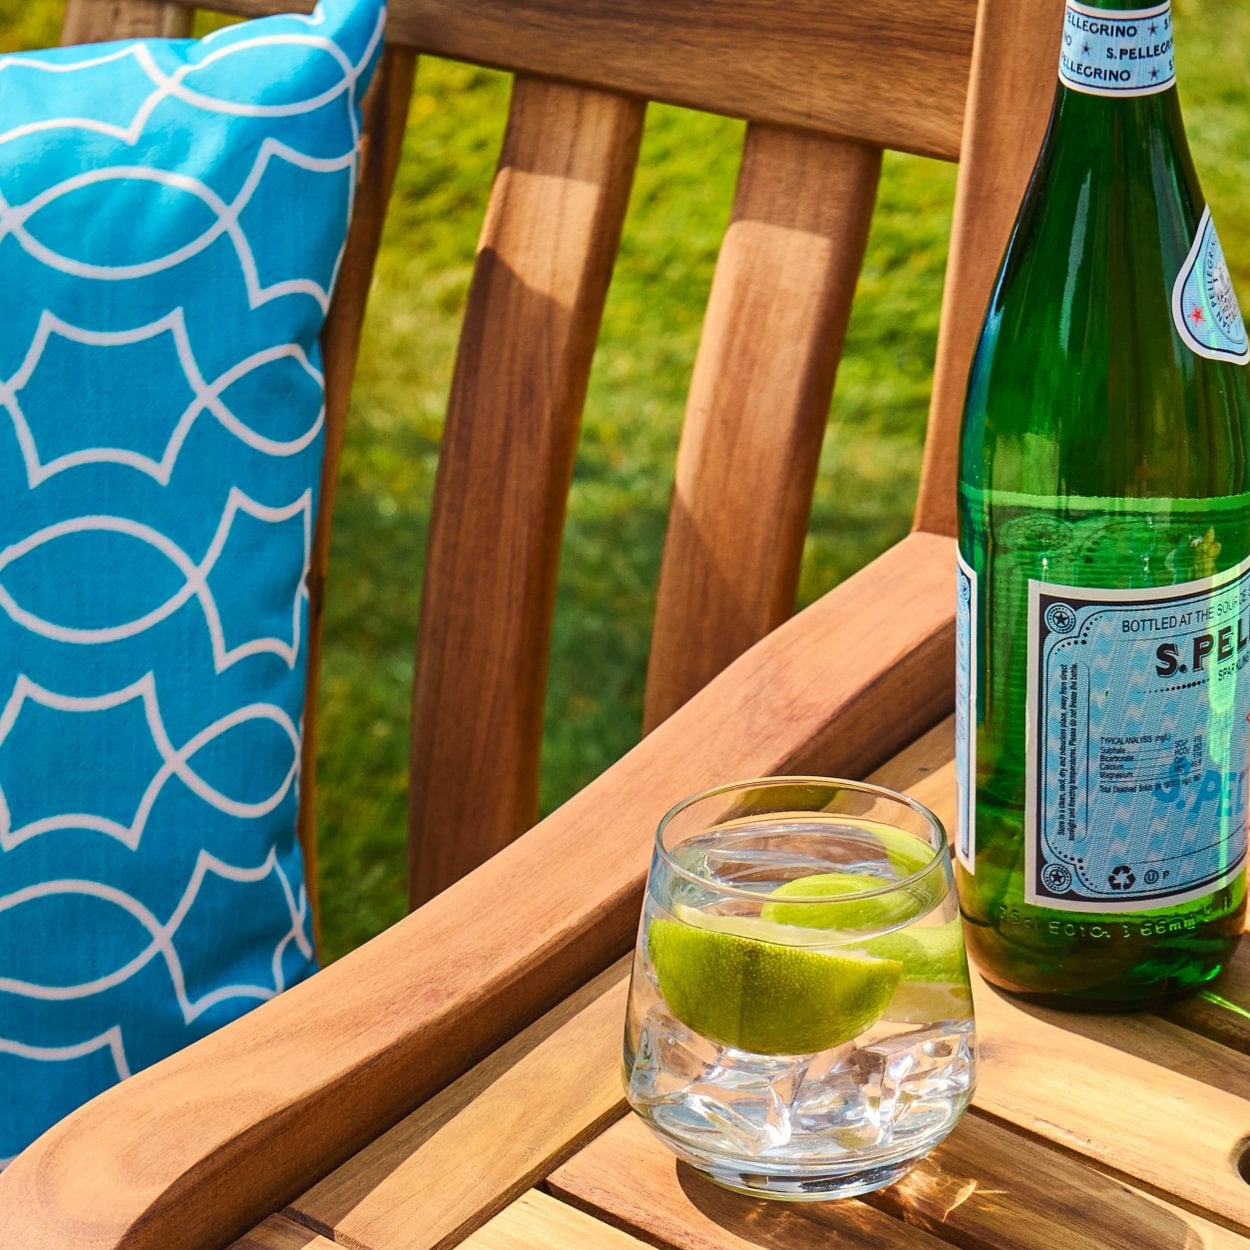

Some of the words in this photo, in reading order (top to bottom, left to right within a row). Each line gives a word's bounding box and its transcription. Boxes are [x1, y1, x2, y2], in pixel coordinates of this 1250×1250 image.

[1067, 11, 1138, 38] ELLEGRINO
[1062, 53, 1131, 81] ELLEGRINO
[1122, 616, 1177, 633] BOTTLED
[1179, 612, 1193, 627] AT
[1195, 607, 1214, 622] THE
